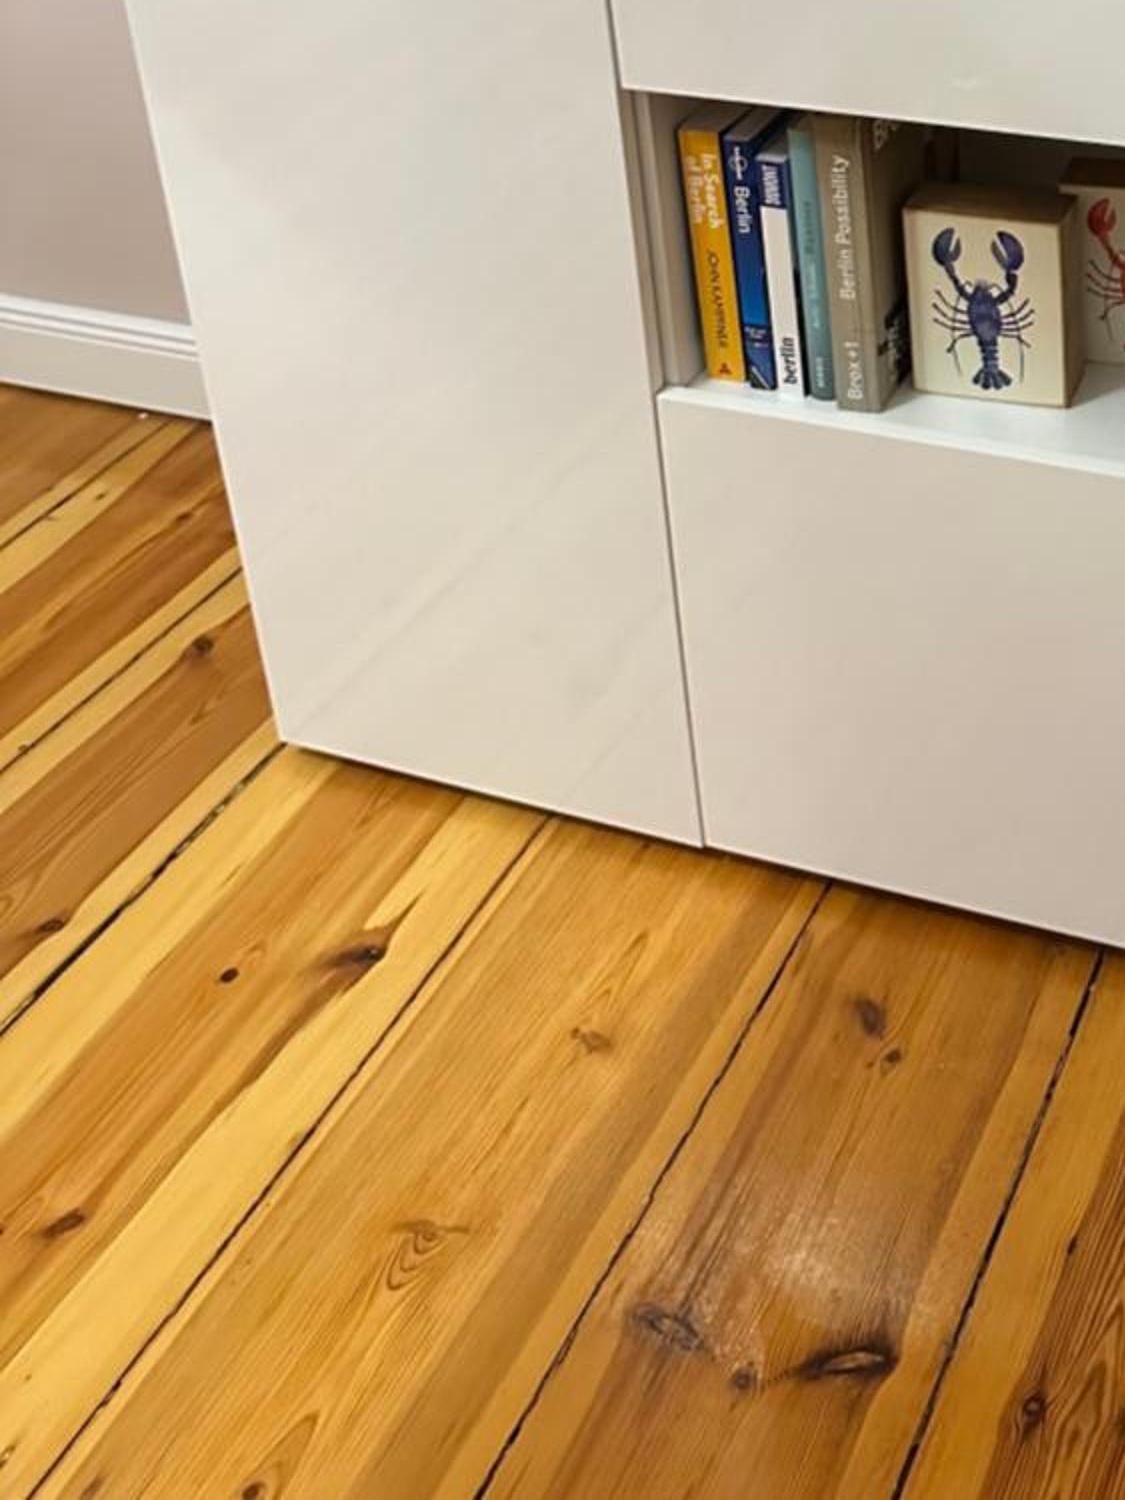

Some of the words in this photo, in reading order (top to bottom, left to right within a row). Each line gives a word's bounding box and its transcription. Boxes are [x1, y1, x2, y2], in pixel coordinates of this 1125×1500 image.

[733, 186, 750, 234] Berlin
[832, 155, 852, 245] Possibility
[838, 247, 856, 300] Berlin
[783, 337, 798, 385] berlin
